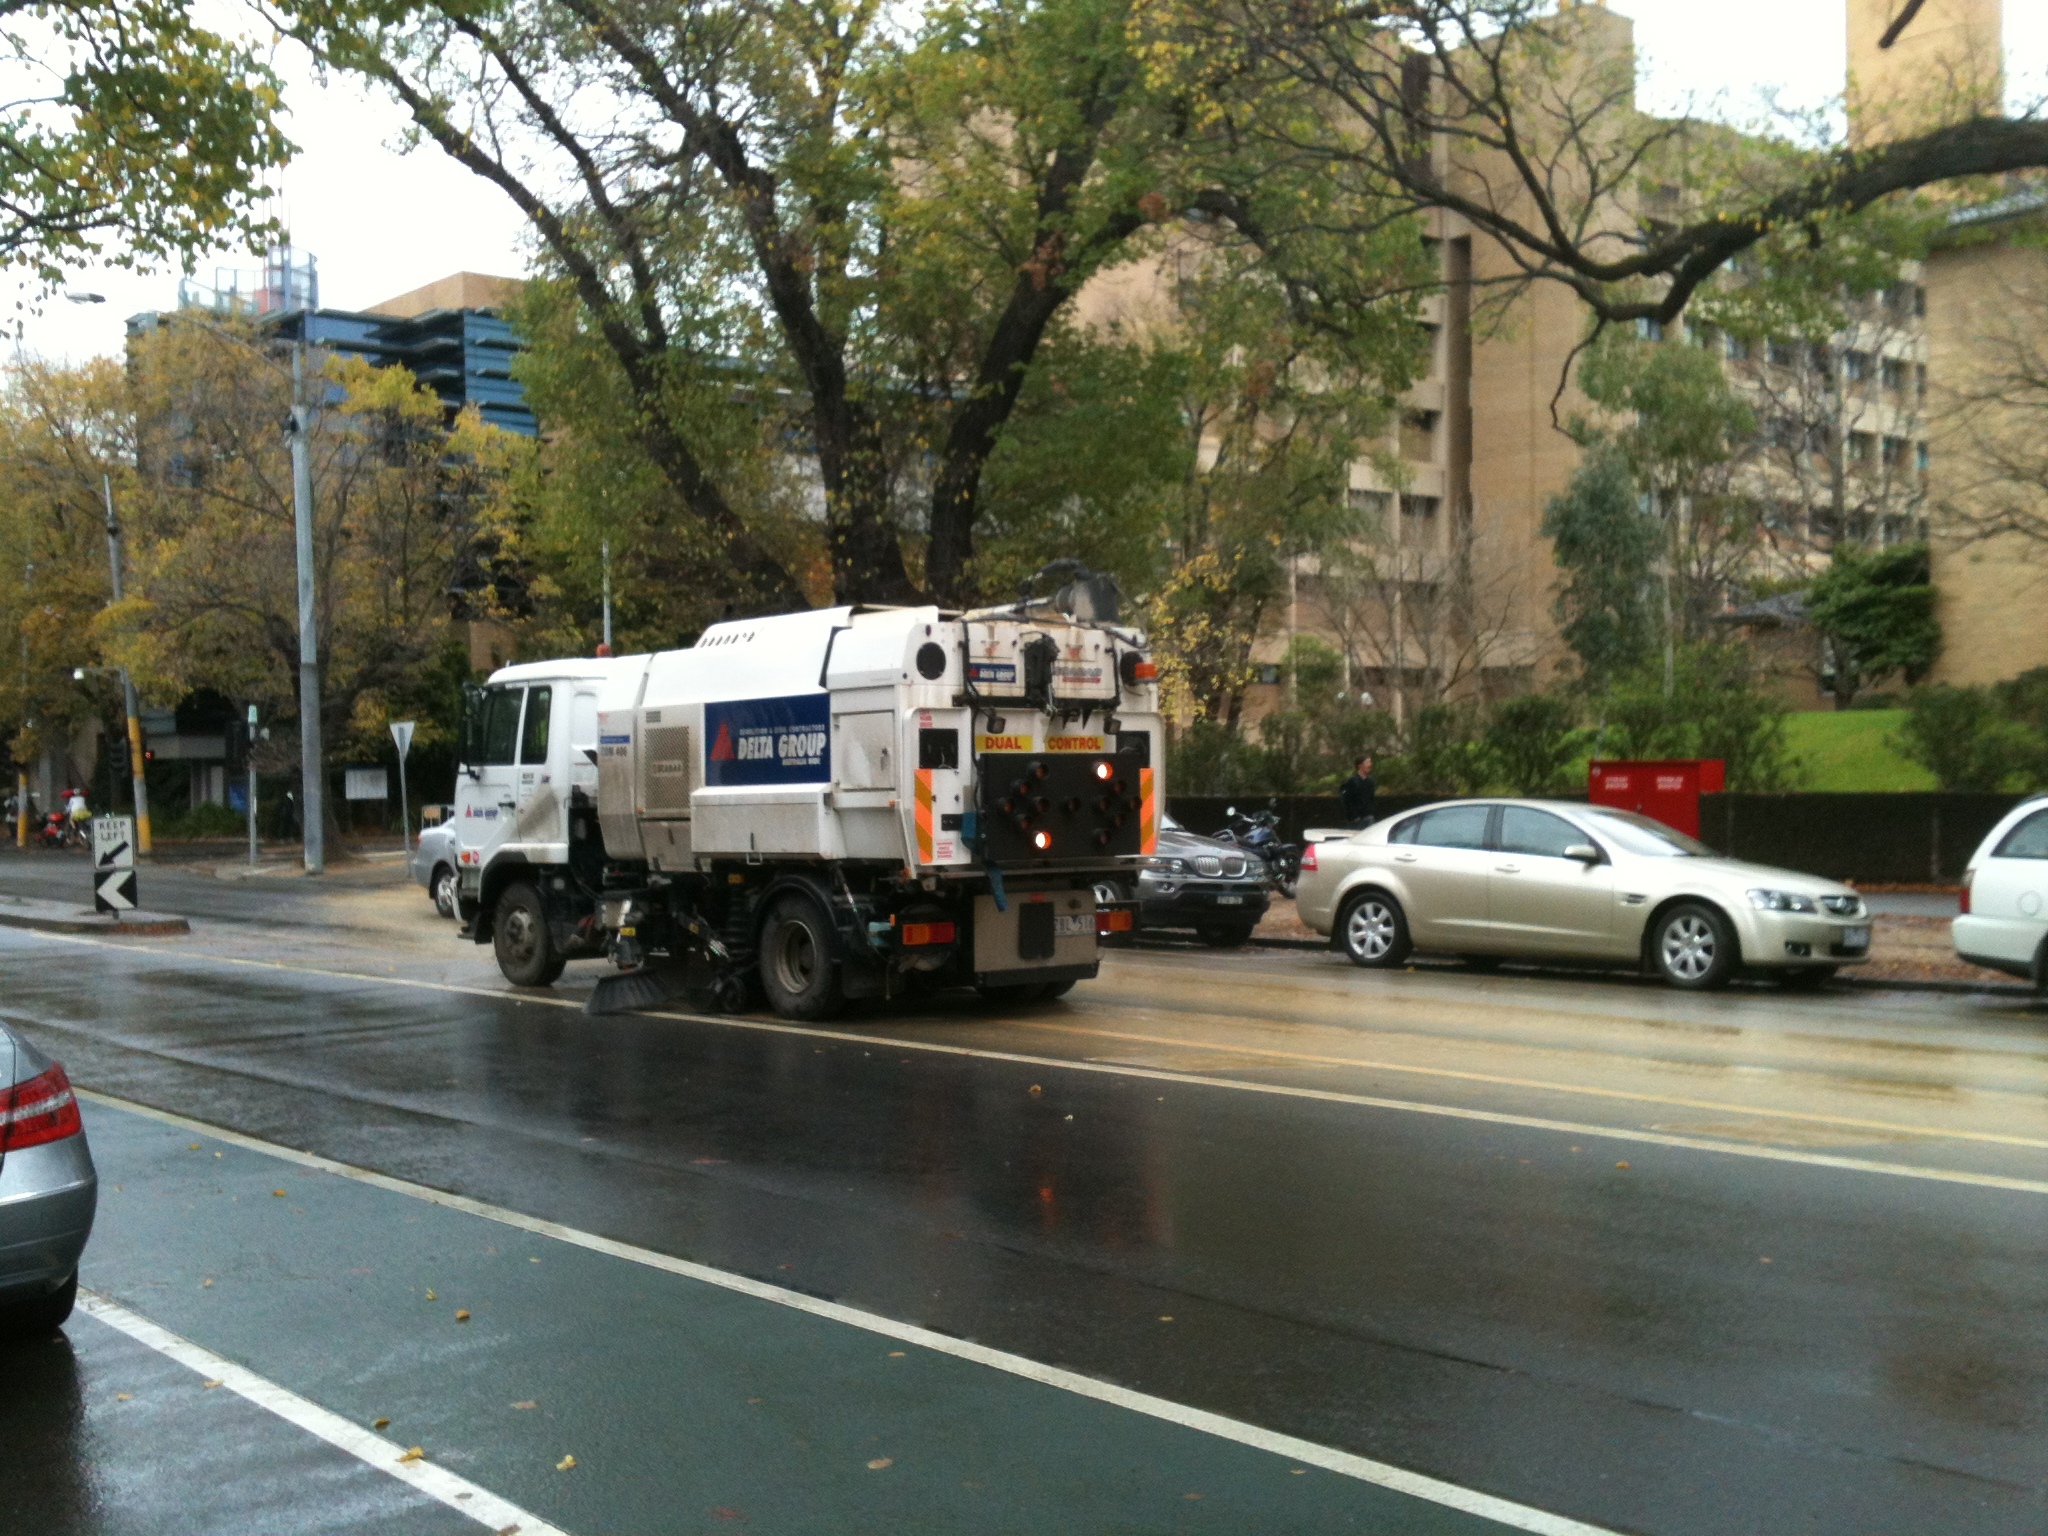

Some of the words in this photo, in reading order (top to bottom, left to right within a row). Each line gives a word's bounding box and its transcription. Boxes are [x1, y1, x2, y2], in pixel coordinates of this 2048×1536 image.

[738, 735, 774, 760] DELTA
[778, 732, 827, 758] GROUP
[984, 736, 1022, 750] DUAL
[1047, 737, 1101, 750] CONTROL
[99, 820, 126, 830] KEEP
[100, 830, 125, 841] LEFT
